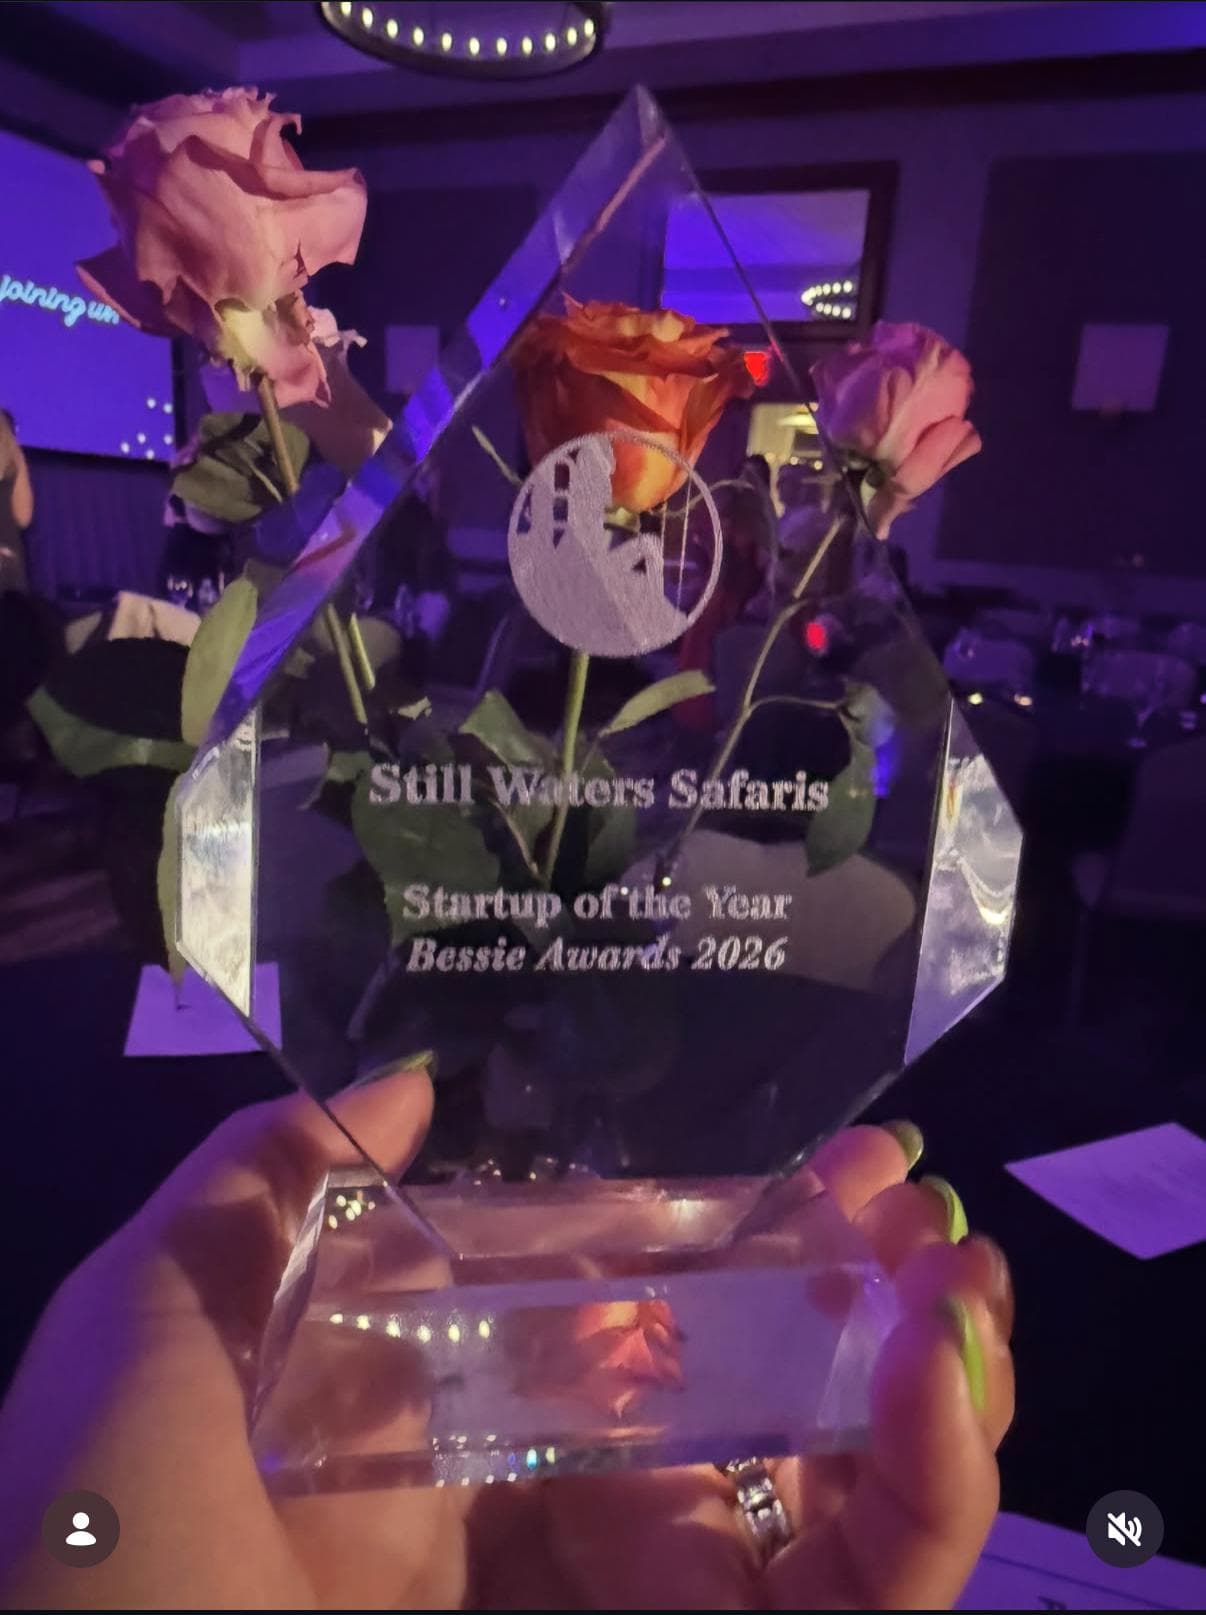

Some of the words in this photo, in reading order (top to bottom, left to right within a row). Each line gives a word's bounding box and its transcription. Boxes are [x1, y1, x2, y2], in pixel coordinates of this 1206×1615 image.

[369, 763, 474, 805] Still
[490, 766, 656, 808] Waters
[668, 769, 830, 811] Safaris
[402, 884, 563, 928] Startup
[573, 885, 618, 920] of
[627, 884, 692, 920] the
[704, 885, 793, 920] Year
[406, 937, 525, 973] Bessie
[535, 934, 682, 972] Awards
[691, 934, 790, 971] 2026
